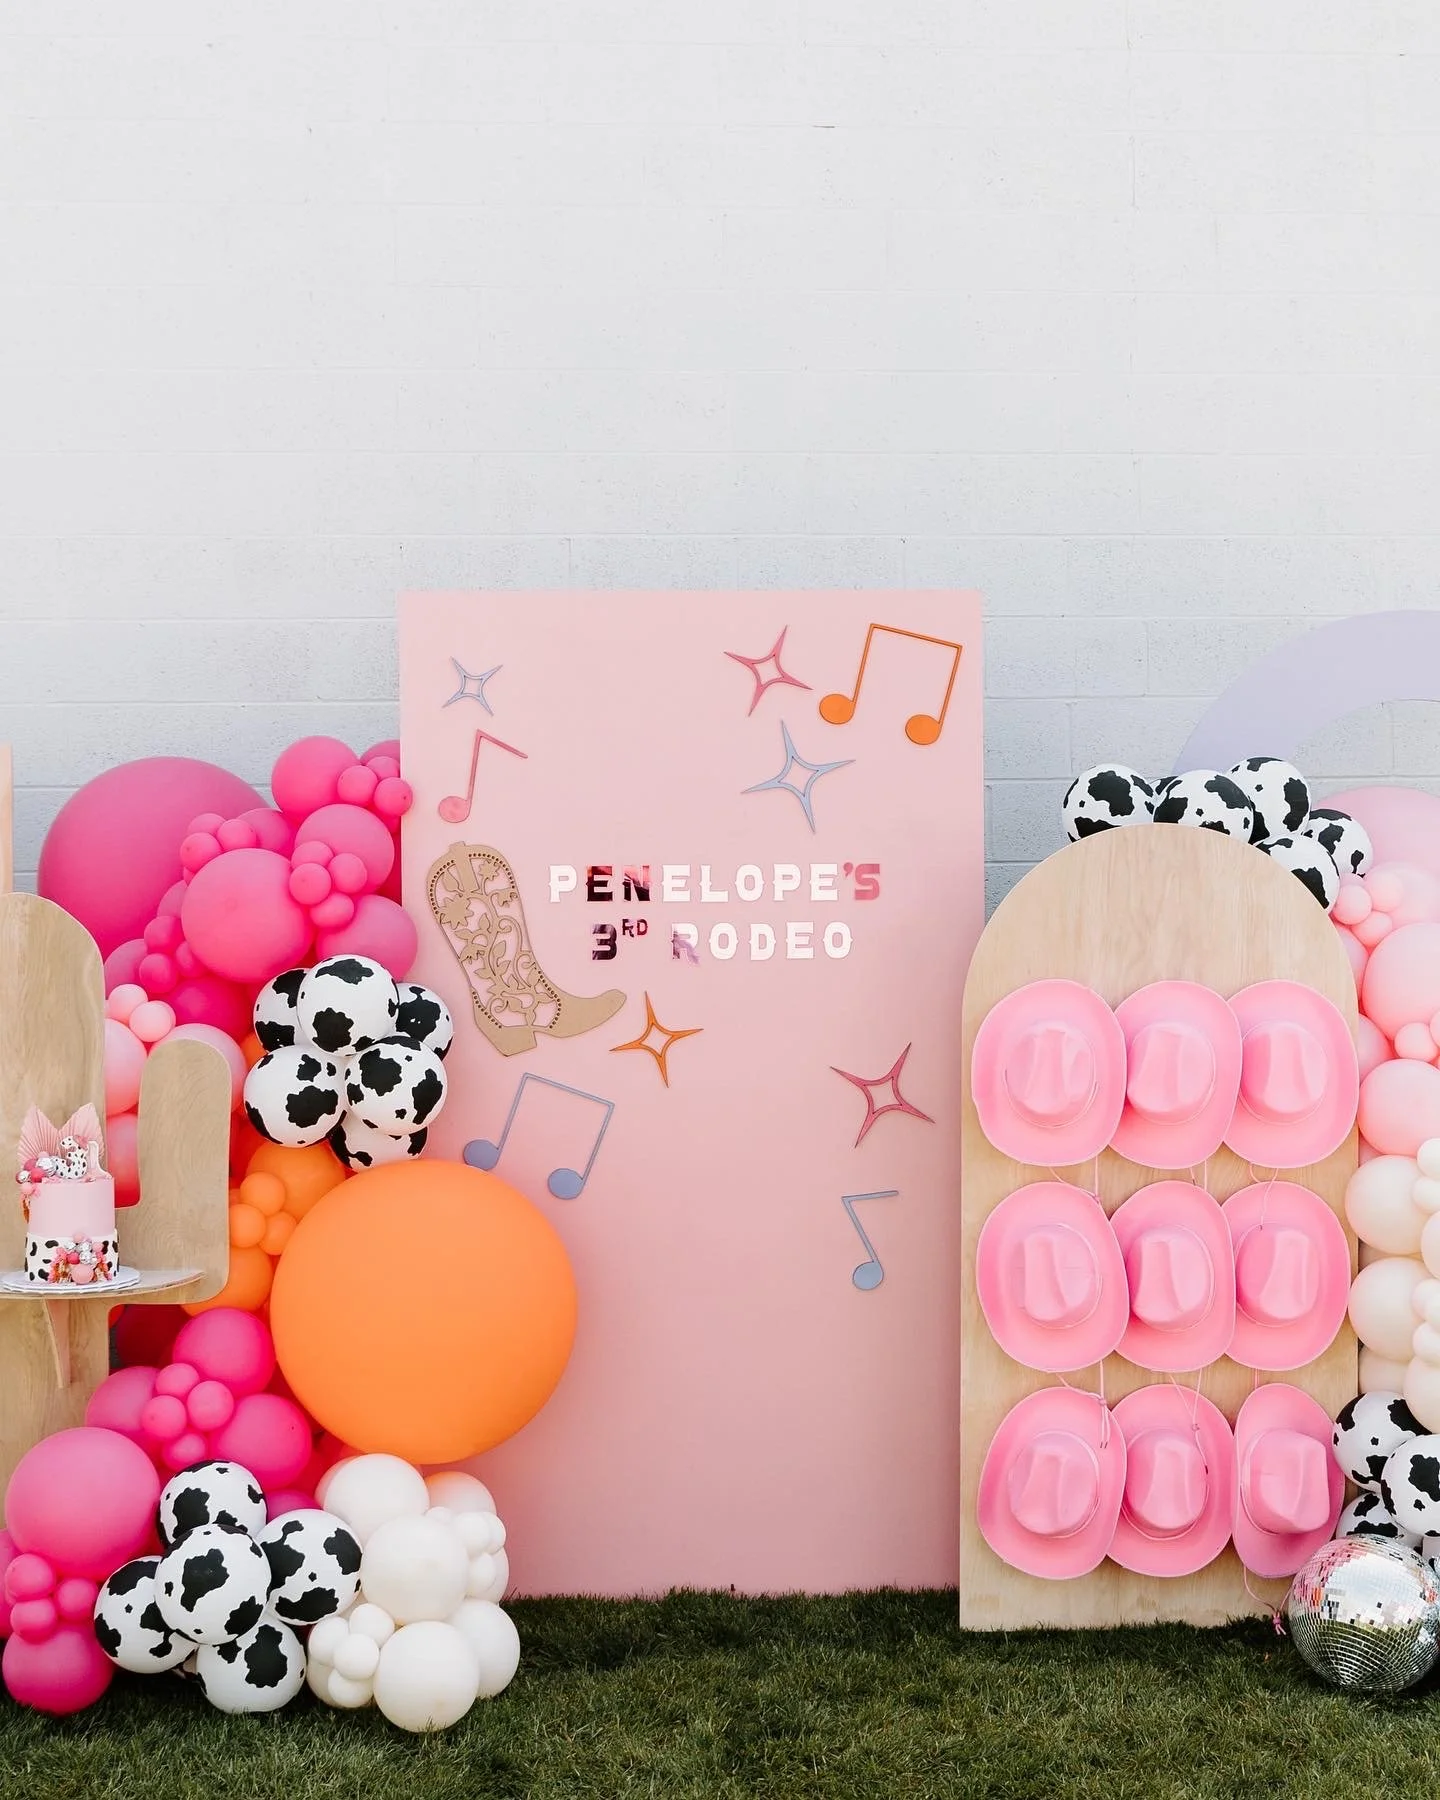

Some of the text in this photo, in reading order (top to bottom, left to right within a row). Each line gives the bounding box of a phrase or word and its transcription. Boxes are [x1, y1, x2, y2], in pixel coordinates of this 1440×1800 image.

[549, 862, 881, 903] PENELOPE'S
[591, 918, 853, 963] 3RD RODEO
